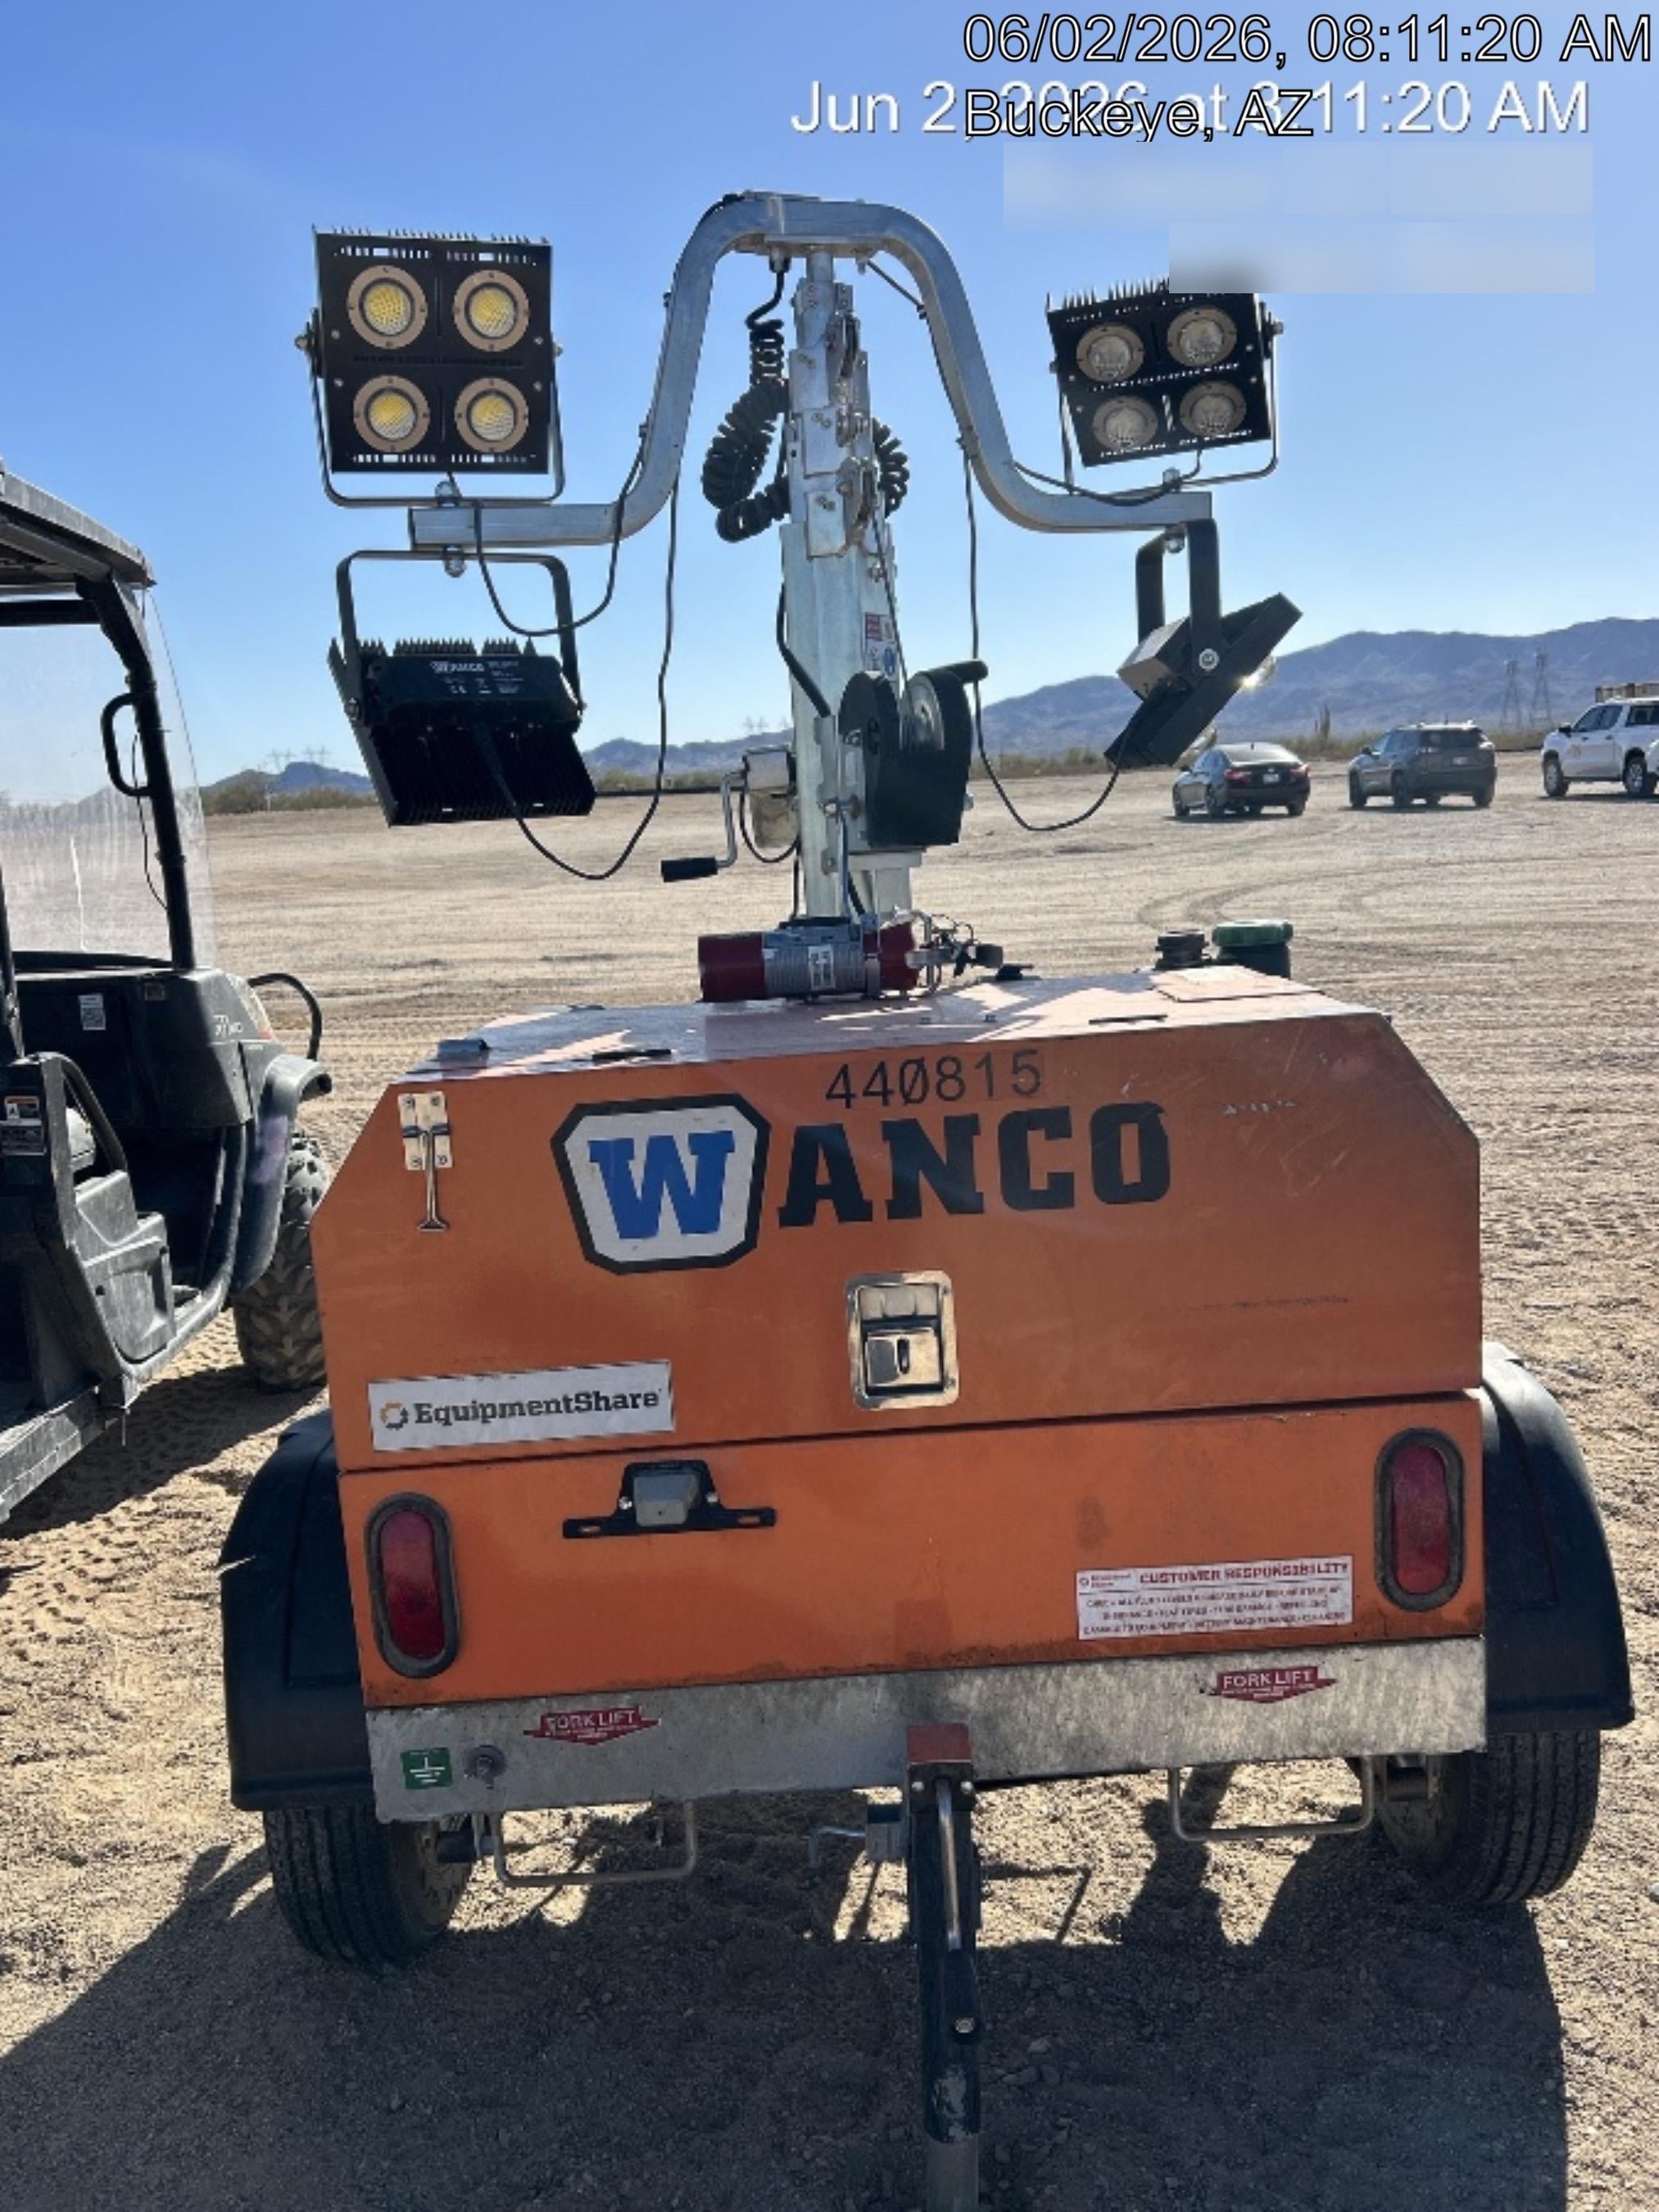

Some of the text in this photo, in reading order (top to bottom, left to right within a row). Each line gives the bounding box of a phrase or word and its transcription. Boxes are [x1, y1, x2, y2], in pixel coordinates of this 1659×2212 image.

[825, 1049, 1043, 1109] 440815
[587, 1099, 1171, 1240] WANCO
[414, 1390, 660, 1426] EquipmentShare
[1140, 1569, 1220, 1584] CUSTOMER
[1224, 1670, 1311, 1689] FORK LIFT
